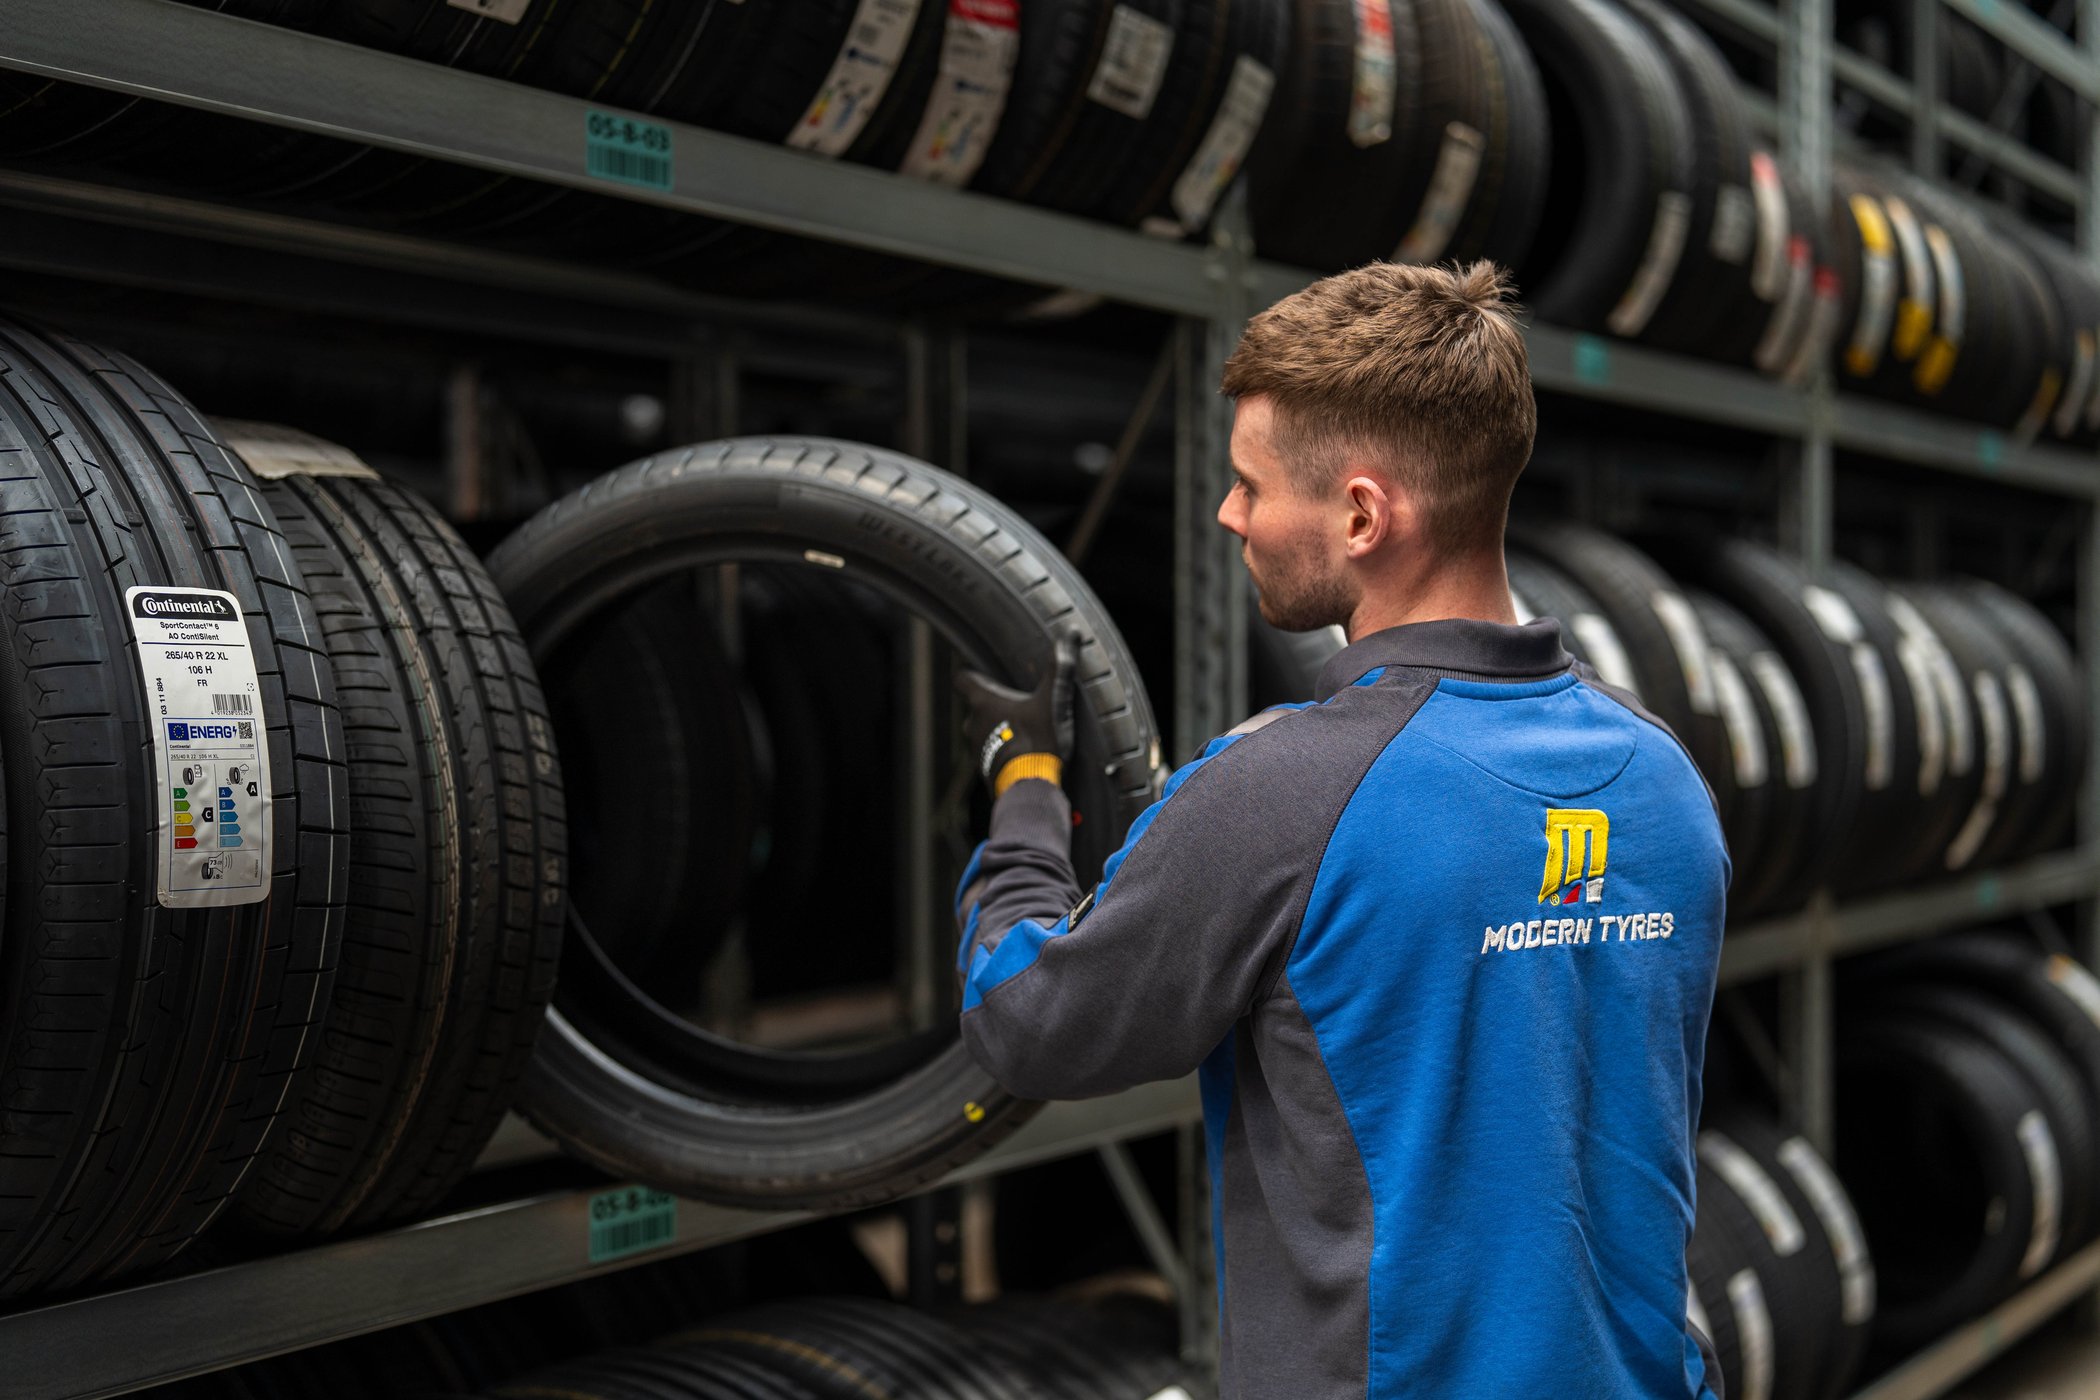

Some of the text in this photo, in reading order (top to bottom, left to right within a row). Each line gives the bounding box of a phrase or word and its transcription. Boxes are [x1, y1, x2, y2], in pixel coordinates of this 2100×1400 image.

[142, 597, 215, 615] Continental
[168, 632, 220, 641] AO ContiSilent
[165, 651, 229, 661] 265/40 R 22 XL
[188, 666, 213, 674] 106 H
[197, 679, 208, 687] FR
[159, 694, 165, 703] 11
[160, 705, 168, 715] 03
[189, 726, 232, 739] ENERG
[250, 785, 257, 794] A
[205, 810, 212, 819] C
[1481, 912, 1674, 954] MODERN TYRES
